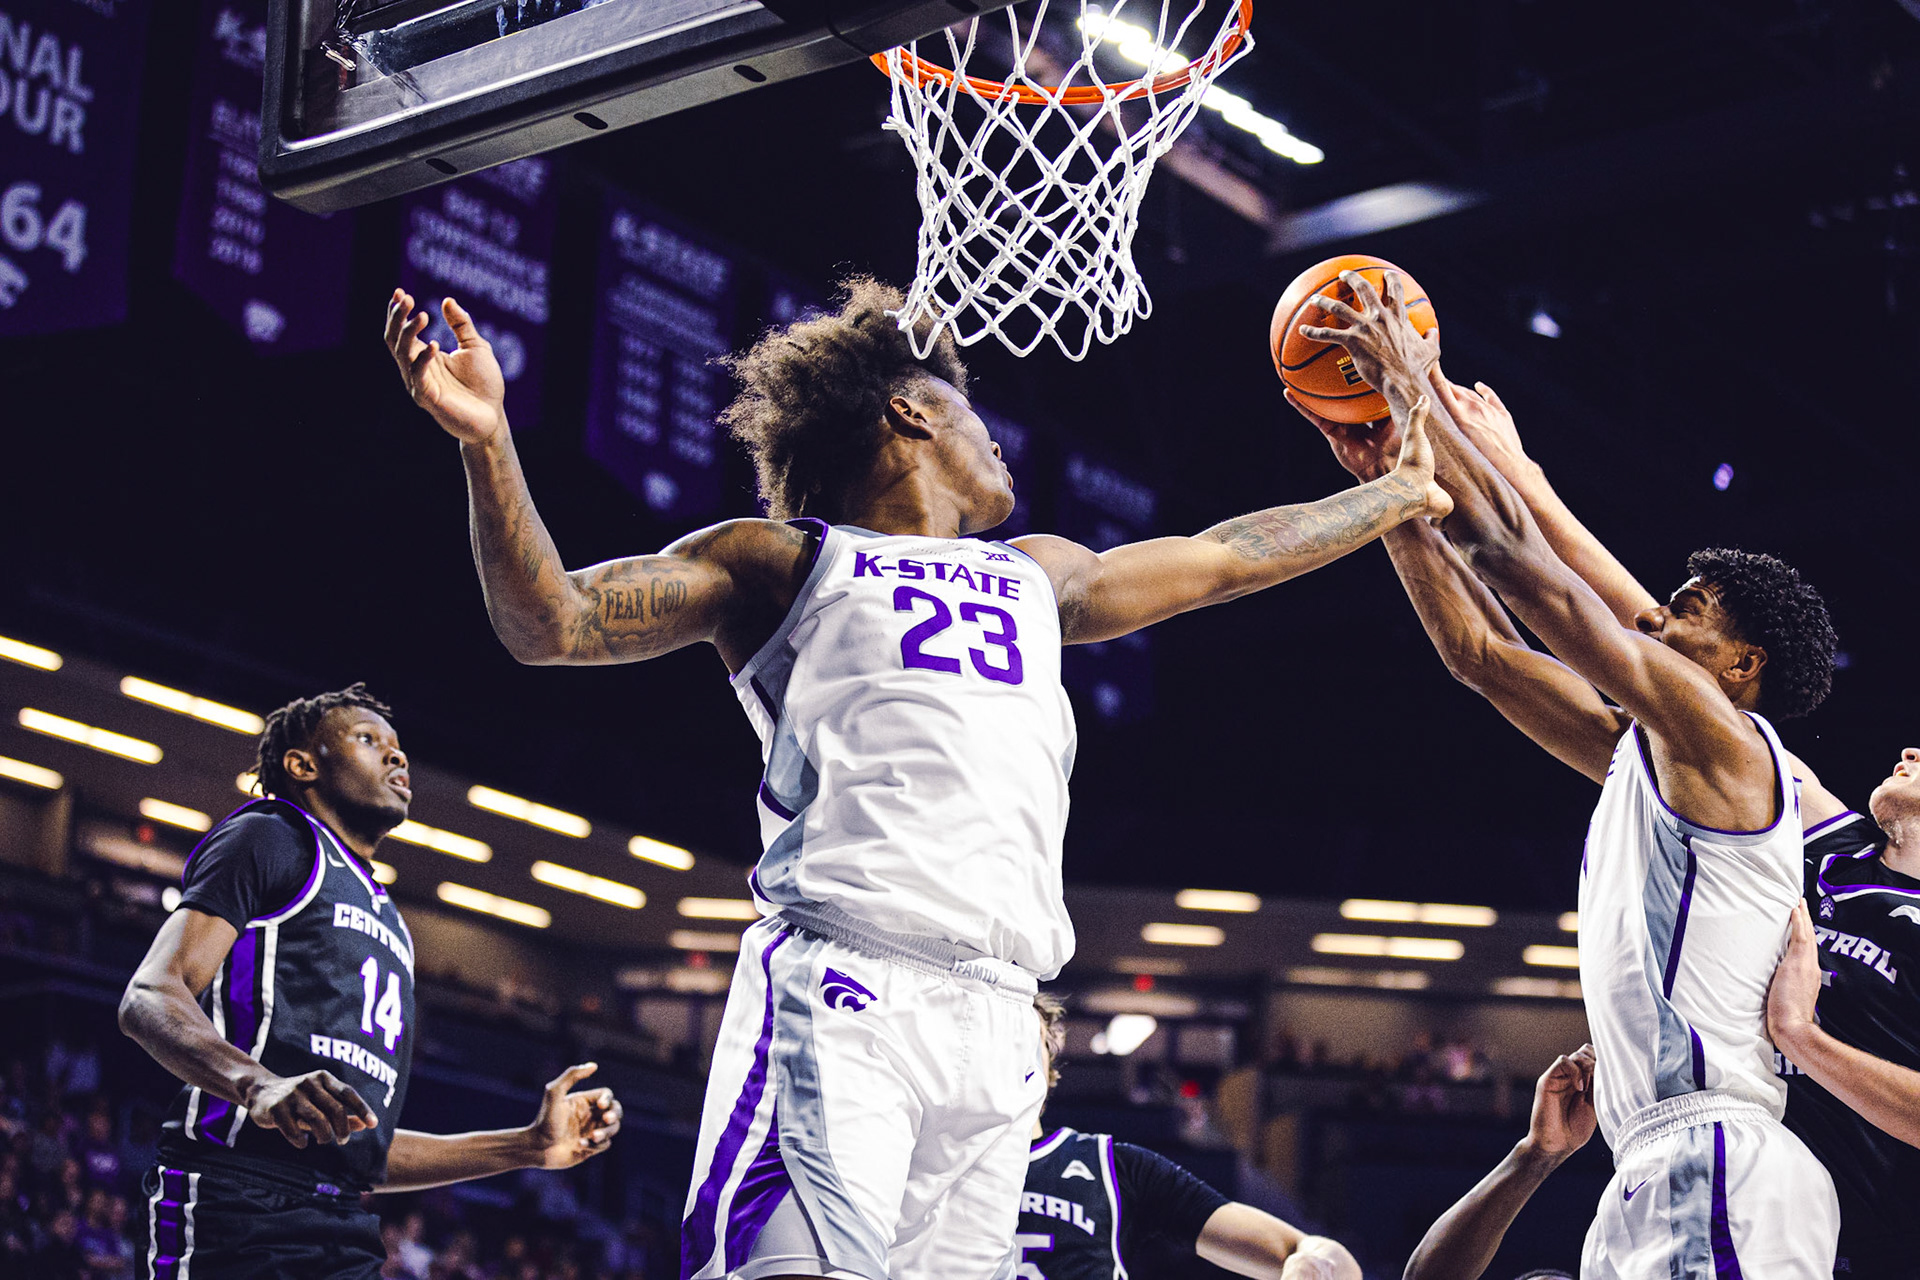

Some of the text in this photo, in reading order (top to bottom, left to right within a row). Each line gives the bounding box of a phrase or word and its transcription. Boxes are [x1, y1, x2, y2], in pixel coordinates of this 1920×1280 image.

[0, 181, 88, 273] 64
[603, 577, 688, 624] FEAR GOD
[853, 551, 1021, 601] K-STATE
[893, 585, 1023, 686] 23
[359, 955, 404, 1055] 14
[956, 962, 1000, 984] FAMILY
